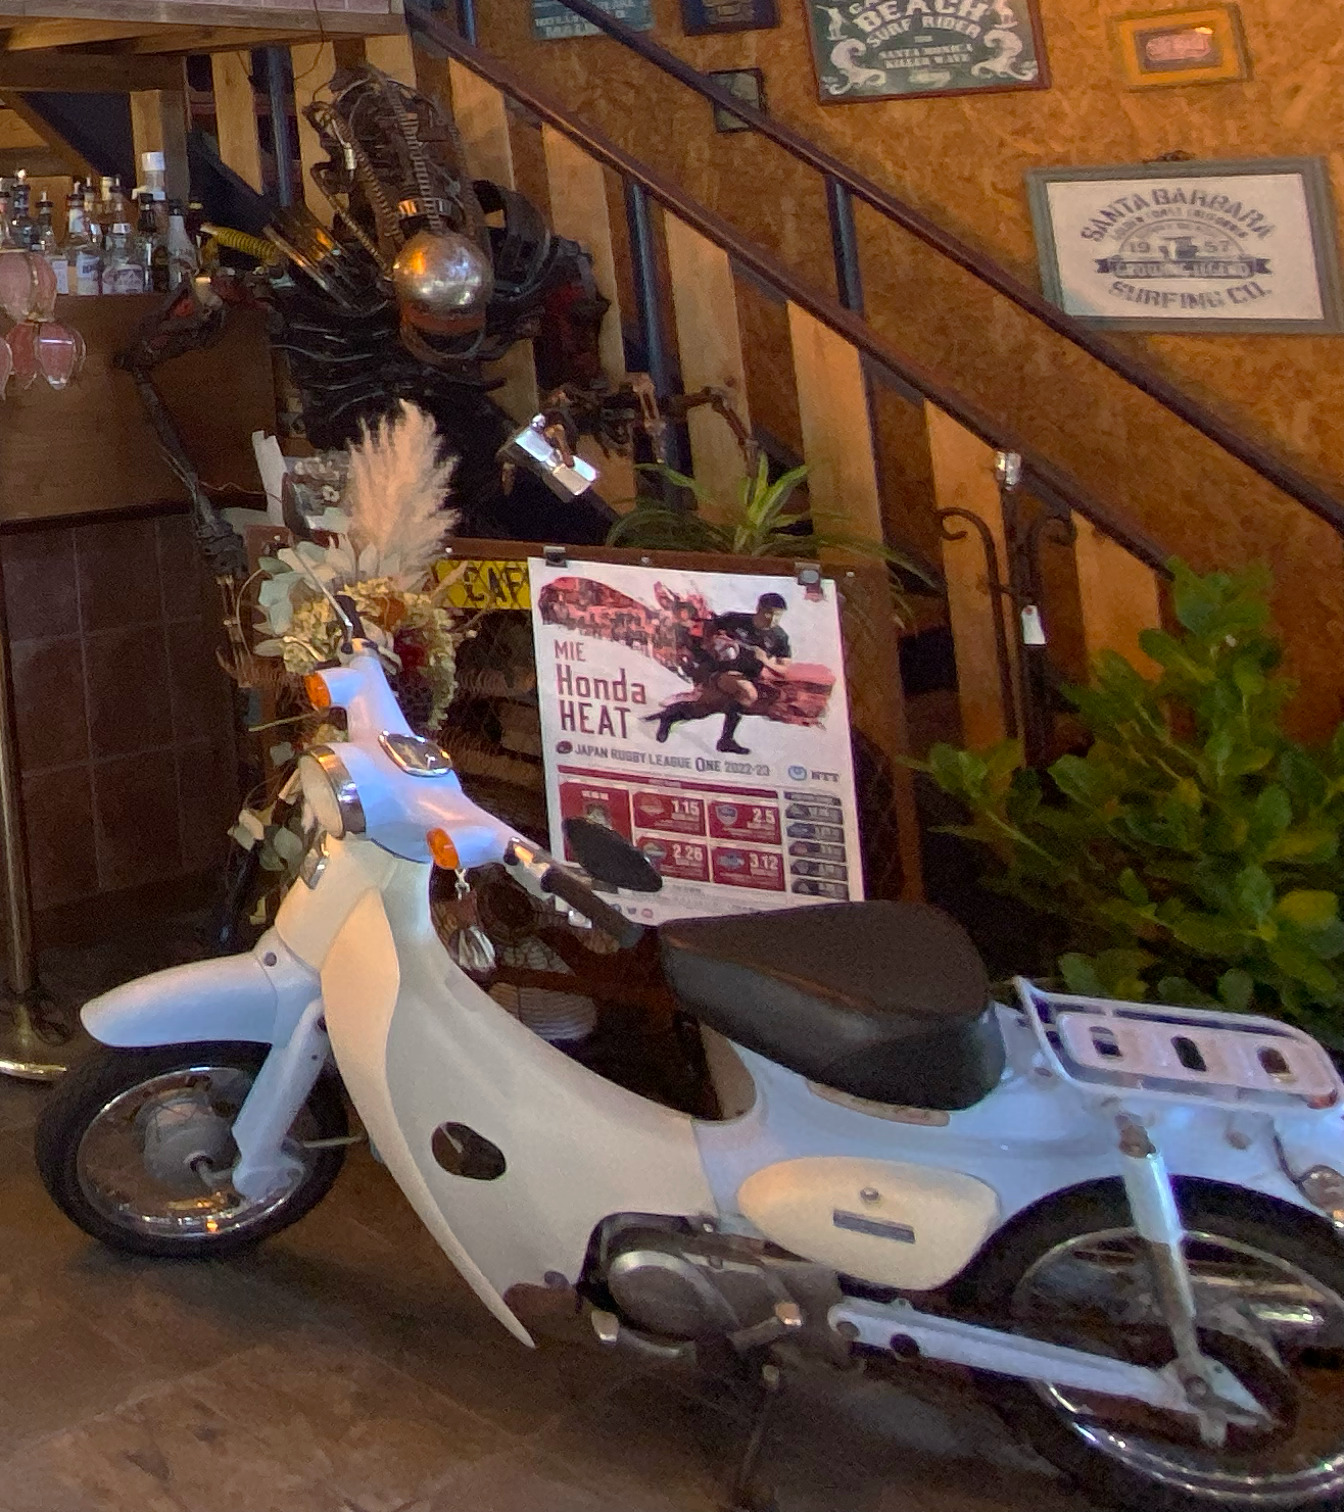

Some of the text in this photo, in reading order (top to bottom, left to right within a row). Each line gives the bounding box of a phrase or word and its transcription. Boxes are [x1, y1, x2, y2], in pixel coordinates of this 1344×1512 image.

[866, 15, 982, 48] SURF RIDER
[1080, 187, 1278, 243] SANTA BARBARA
[1109, 280, 1227, 310] SURFING
[554, 639, 586, 662] MIE
[556, 663, 647, 705] Honda
[559, 699, 631, 739] HEAT
[574, 746, 608, 760] JAPAN
[611, 748, 646, 764] RUGBY
[648, 753, 692, 769] LEAGUE
[695, 756, 721, 773] ONE
[751, 807, 777, 825] 2.5
[749, 853, 780, 871] 3.12
